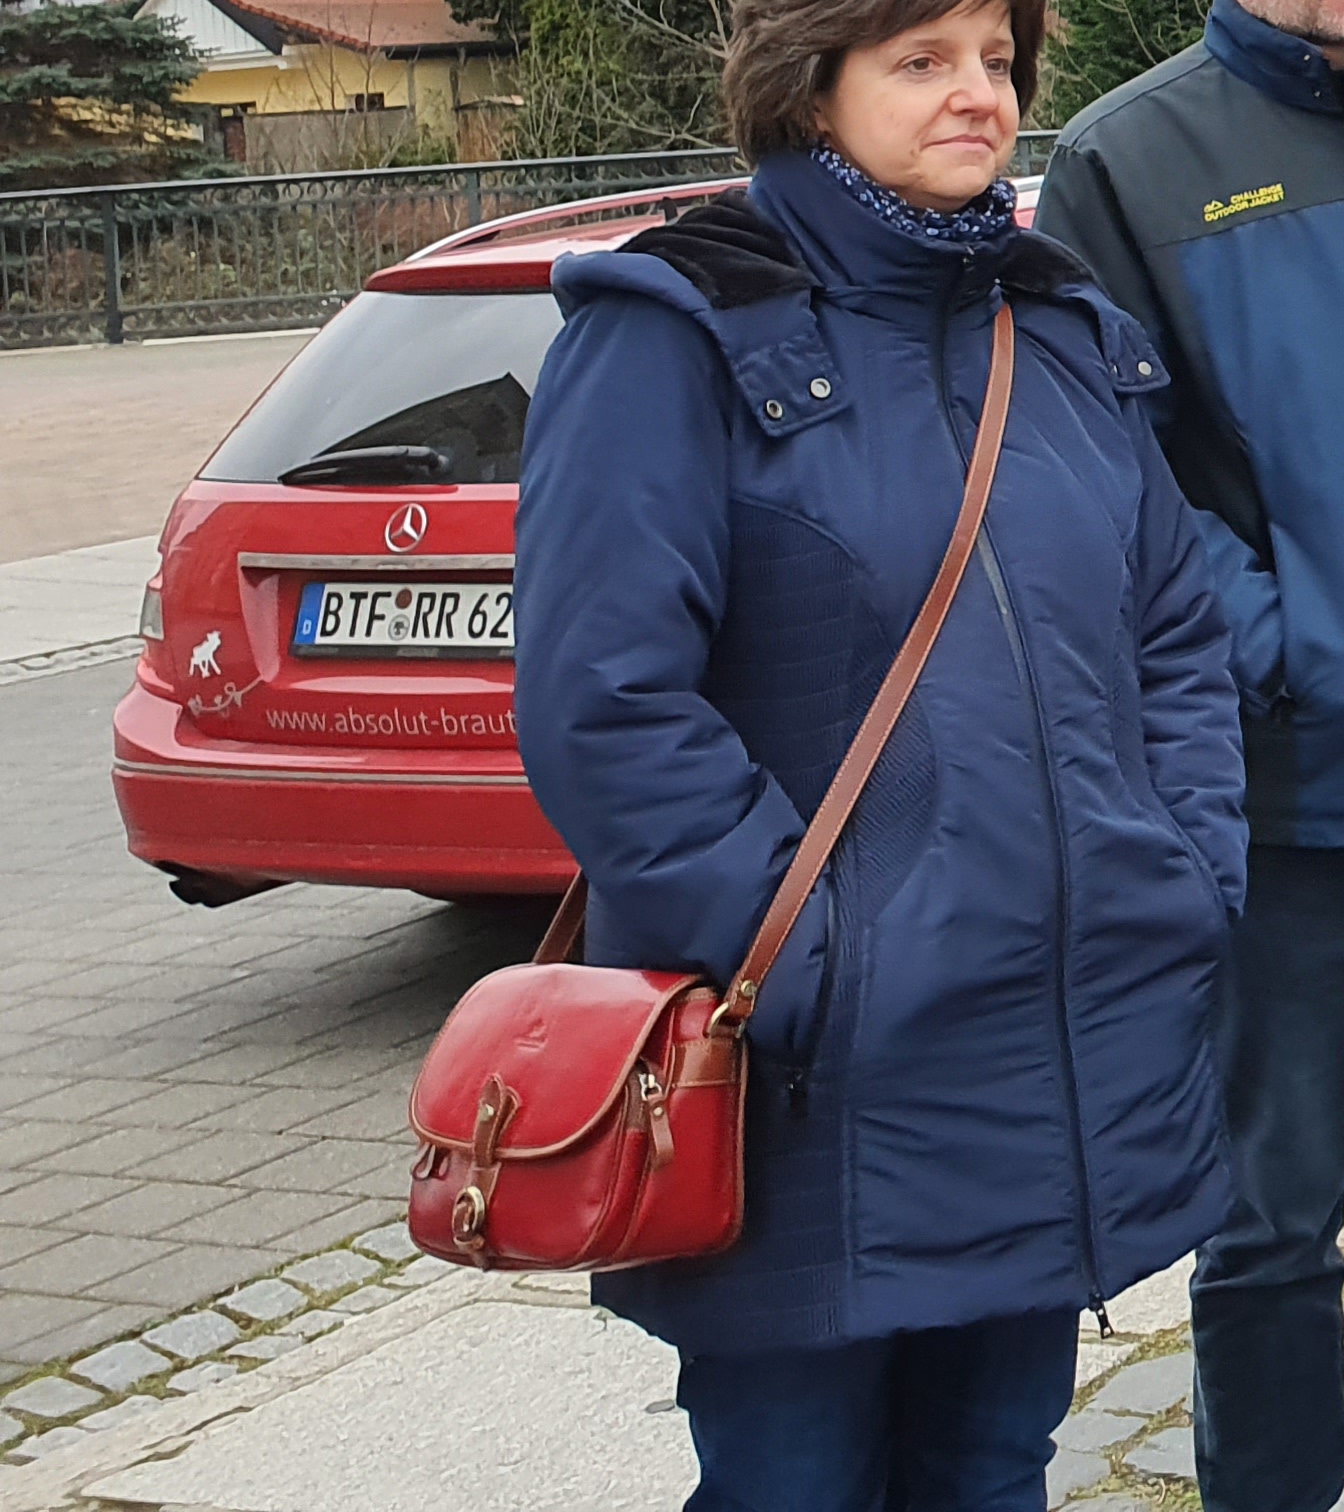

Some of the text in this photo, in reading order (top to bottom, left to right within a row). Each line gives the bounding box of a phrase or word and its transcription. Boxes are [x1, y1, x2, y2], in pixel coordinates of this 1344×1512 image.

[1204, 191, 1285, 222] OUTDOOR JACKET
[1230, 182, 1283, 205] CHALLENGE
[319, 591, 392, 638] BTF
[411, 591, 460, 639] RR
[467, 592, 514, 639] 62
